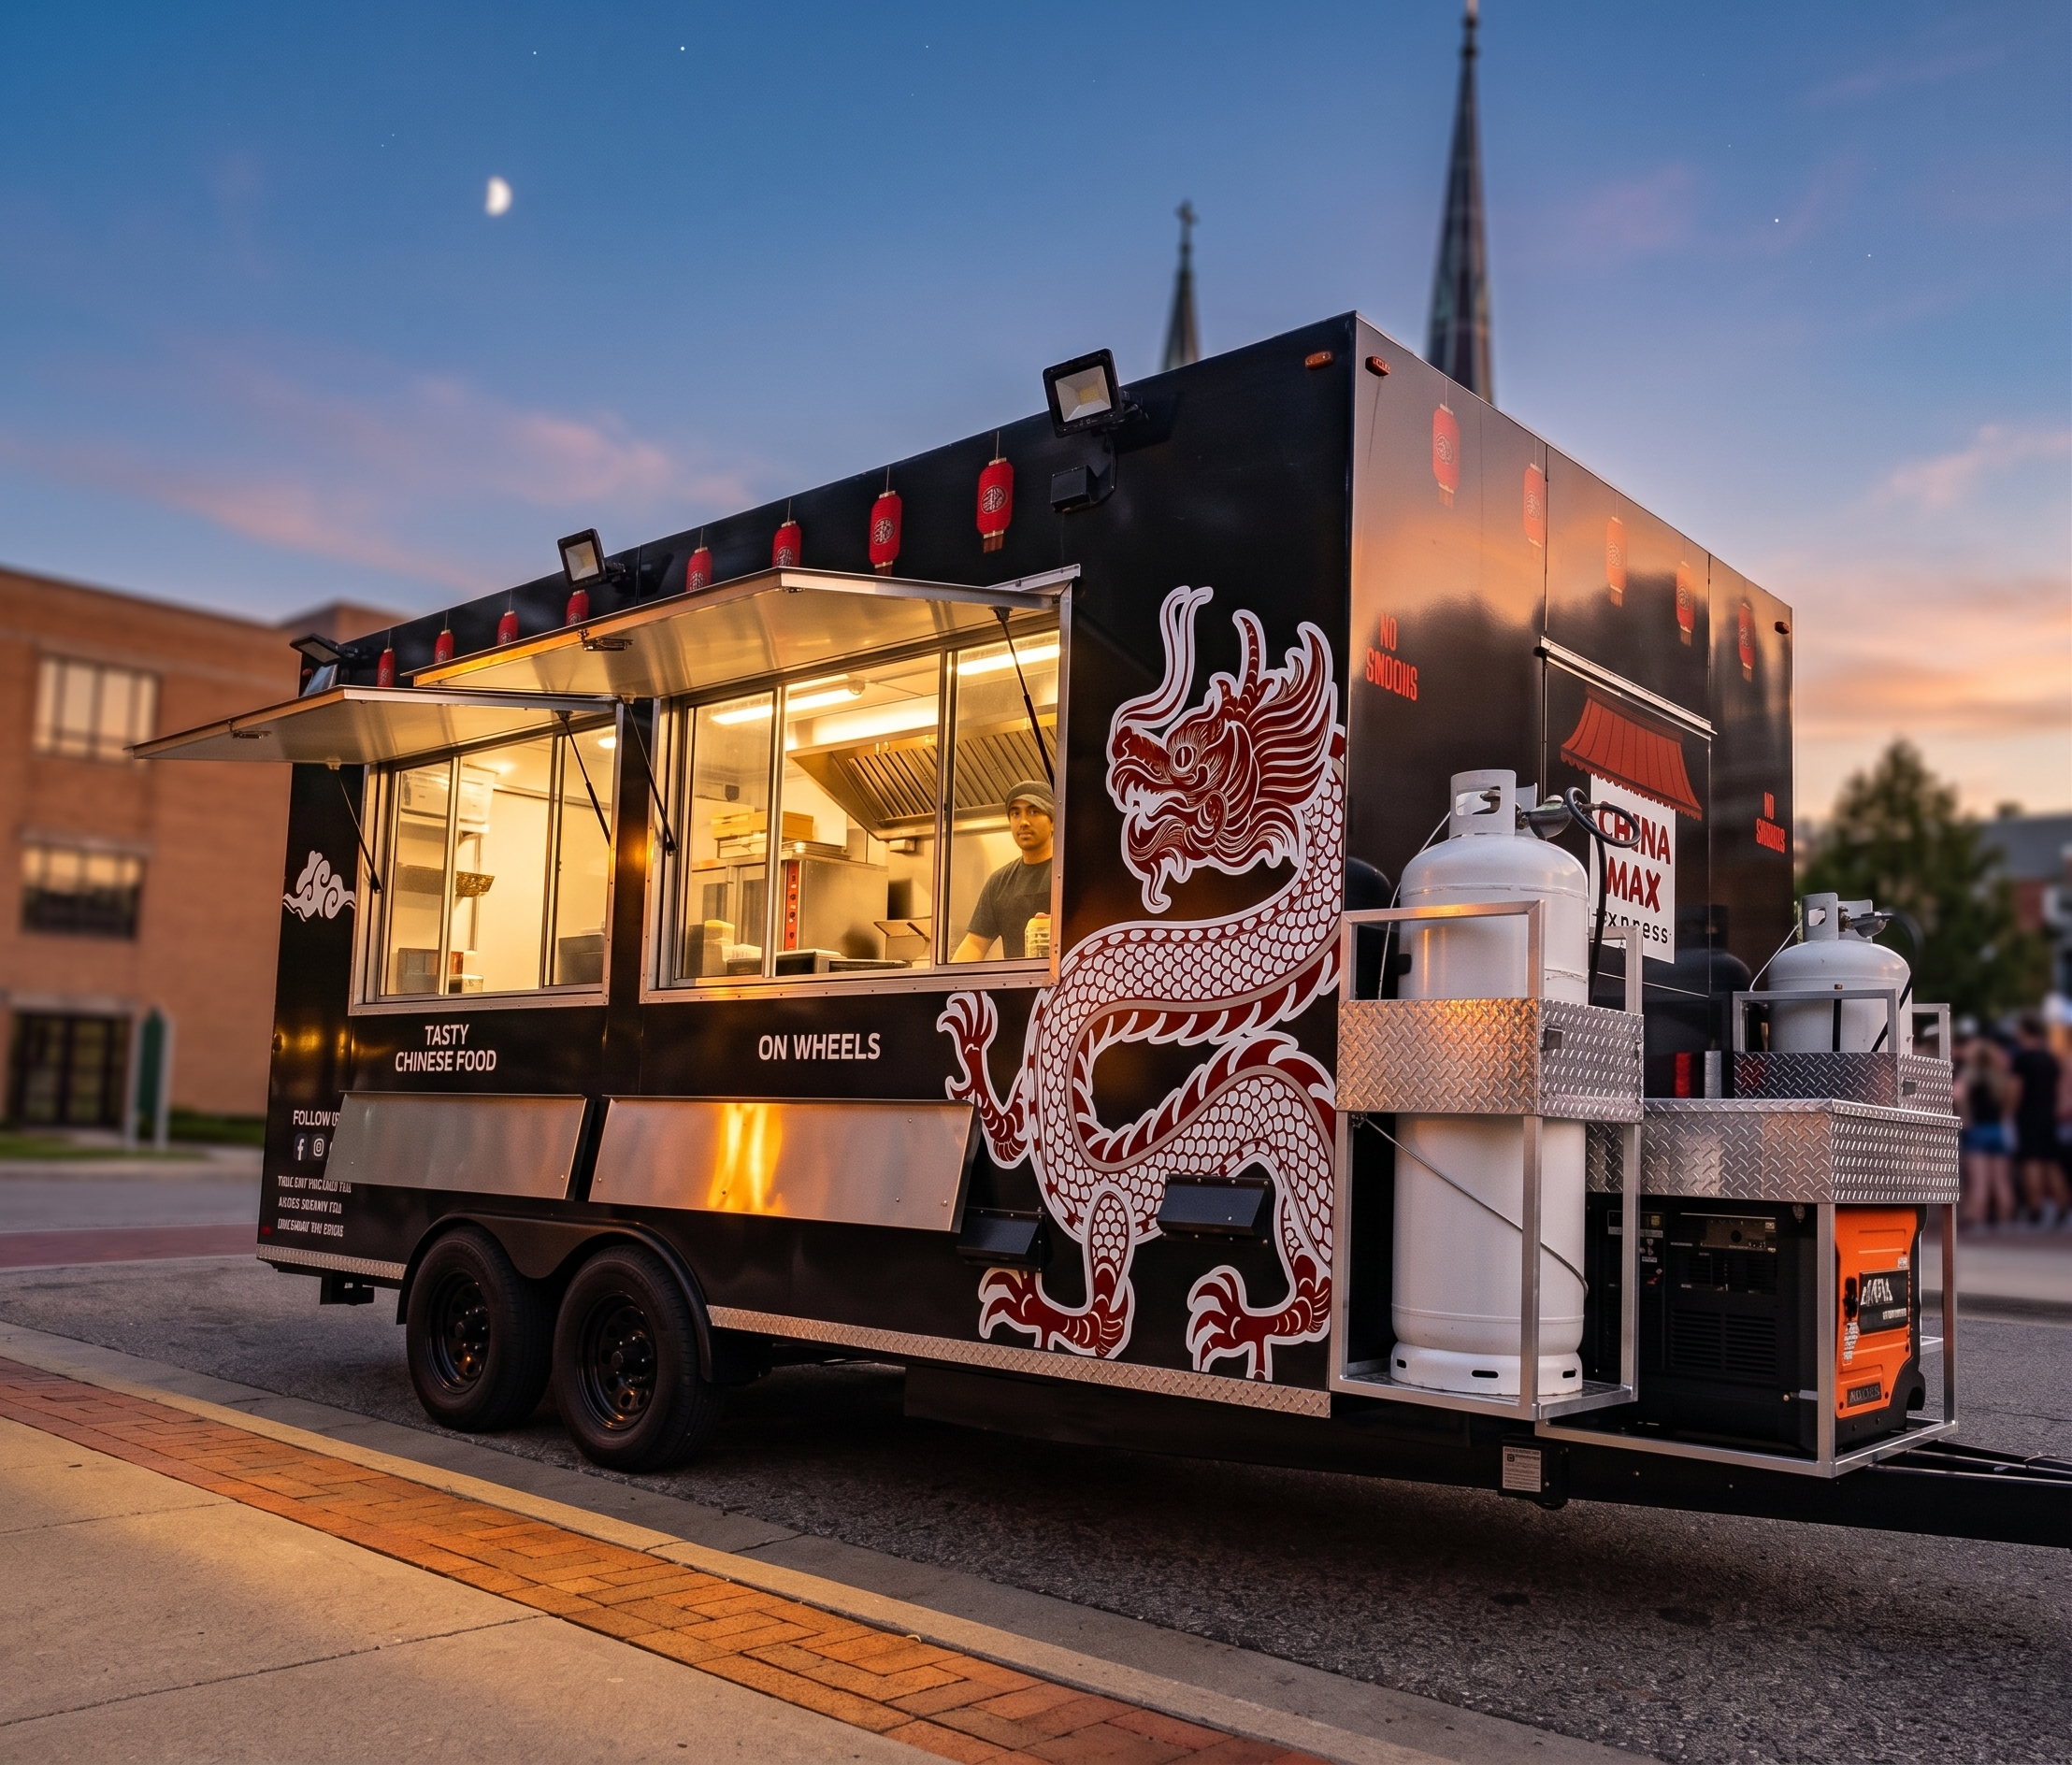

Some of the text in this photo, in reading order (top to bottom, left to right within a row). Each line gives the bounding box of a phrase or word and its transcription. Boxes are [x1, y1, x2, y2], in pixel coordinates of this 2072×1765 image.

[1606, 855, 1662, 913] MAX
[424, 1024, 469, 1046] TASTY
[758, 1032, 881, 1061] ON WHEELS
[395, 1050, 496, 1072] CHINESE FOOD
[293, 1110, 331, 1126] FOLLOW
